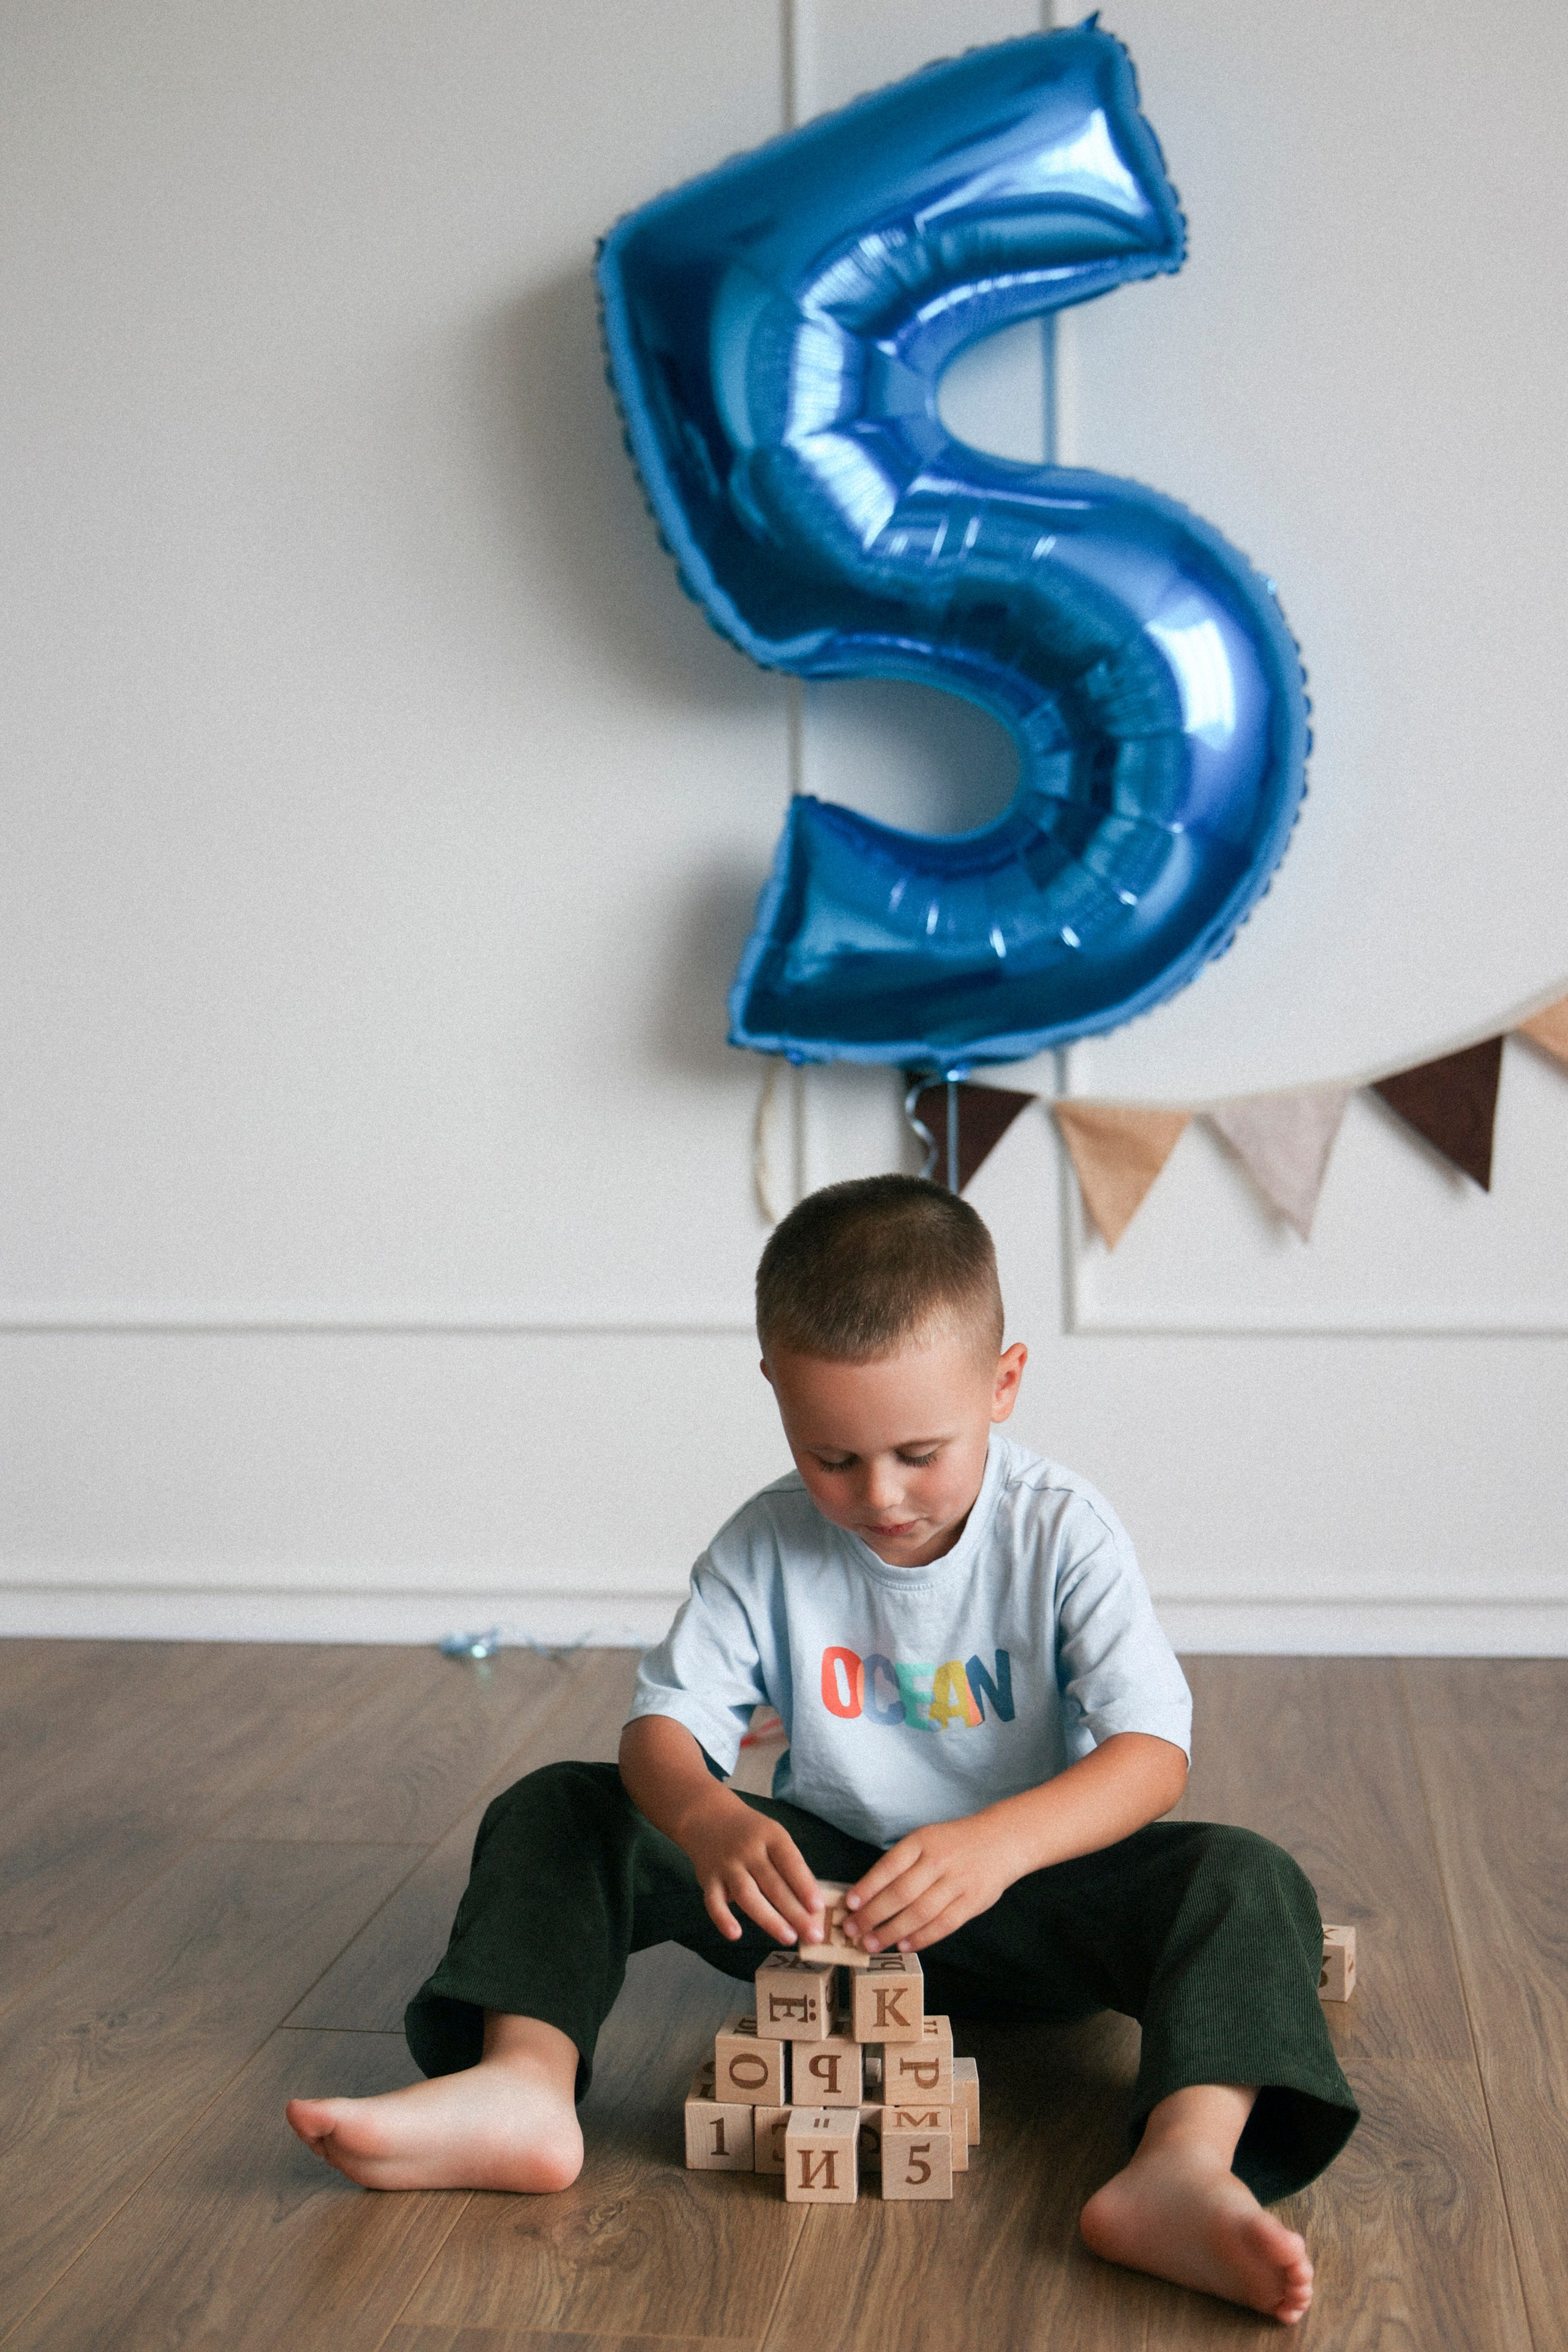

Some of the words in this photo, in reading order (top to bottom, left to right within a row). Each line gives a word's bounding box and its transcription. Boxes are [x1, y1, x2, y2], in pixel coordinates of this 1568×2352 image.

[821, 1646, 1016, 1733] OCEAN
[709, 2117, 730, 2156] 1
[796, 2149, 840, 2190] И
[905, 2142, 932, 2185] 5
